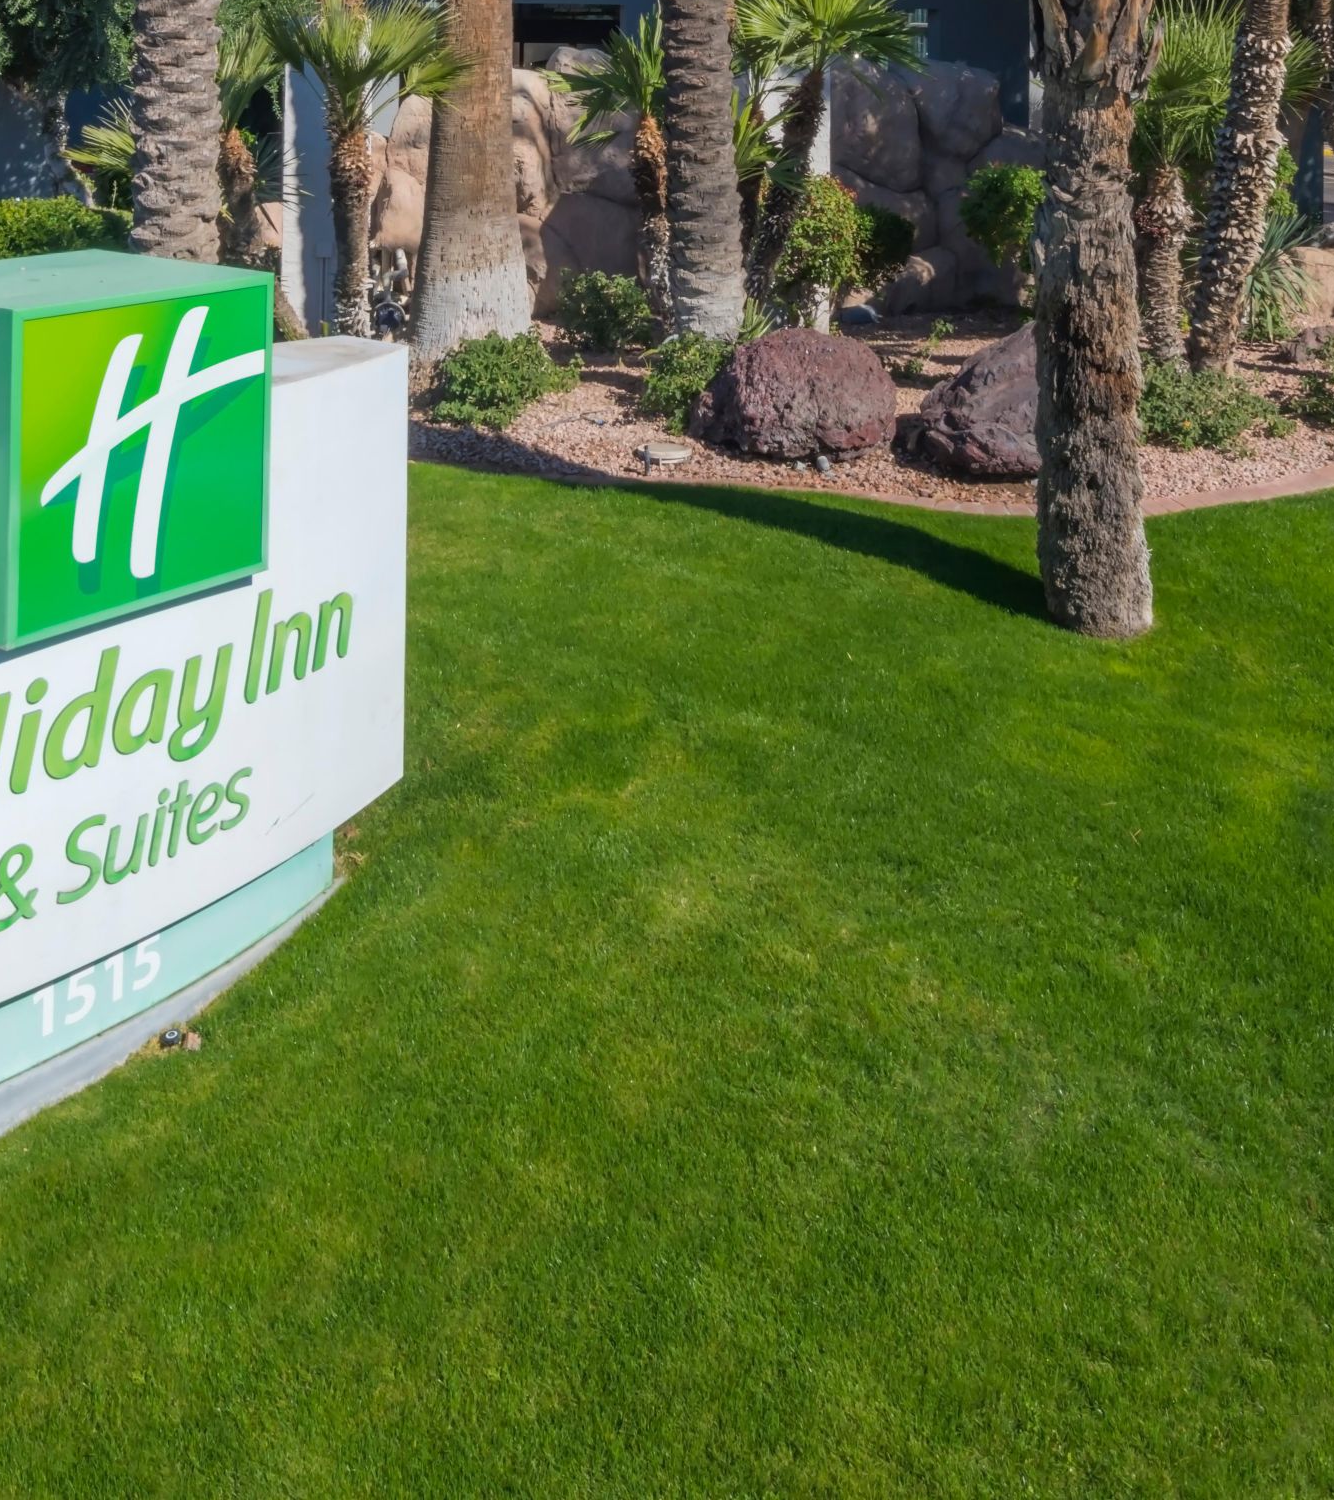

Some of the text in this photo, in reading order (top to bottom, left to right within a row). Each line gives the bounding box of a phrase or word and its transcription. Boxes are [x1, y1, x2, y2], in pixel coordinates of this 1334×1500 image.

[40, 305, 265, 579] H
[244, 588, 353, 704] Inn
[56, 766, 252, 905] Suites
[33, 934, 161, 1037] 1515
